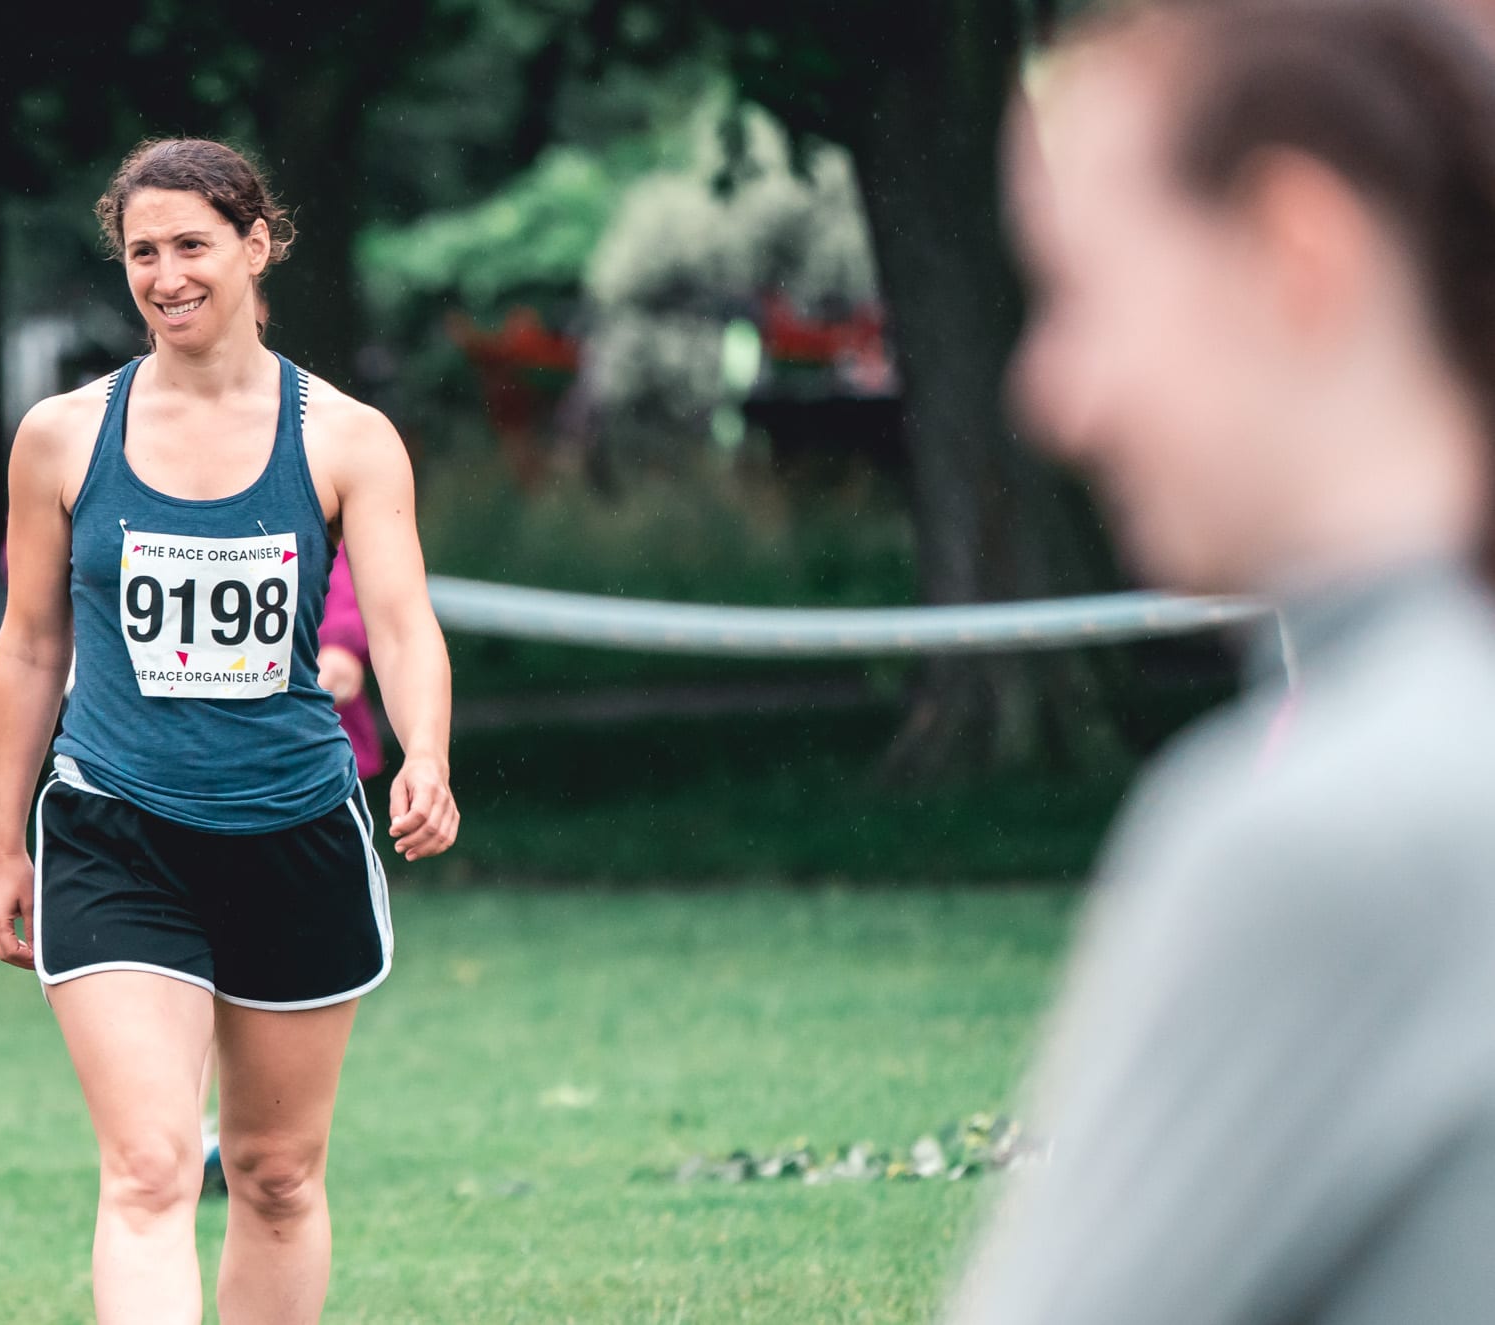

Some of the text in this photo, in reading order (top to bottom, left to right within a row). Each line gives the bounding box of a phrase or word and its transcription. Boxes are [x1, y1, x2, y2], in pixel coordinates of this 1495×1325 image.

[141, 545, 281, 562] THE RACE ORGANISER
[126, 575, 288, 646] 9198
[135, 670, 259, 683] HERACEORGANISER
